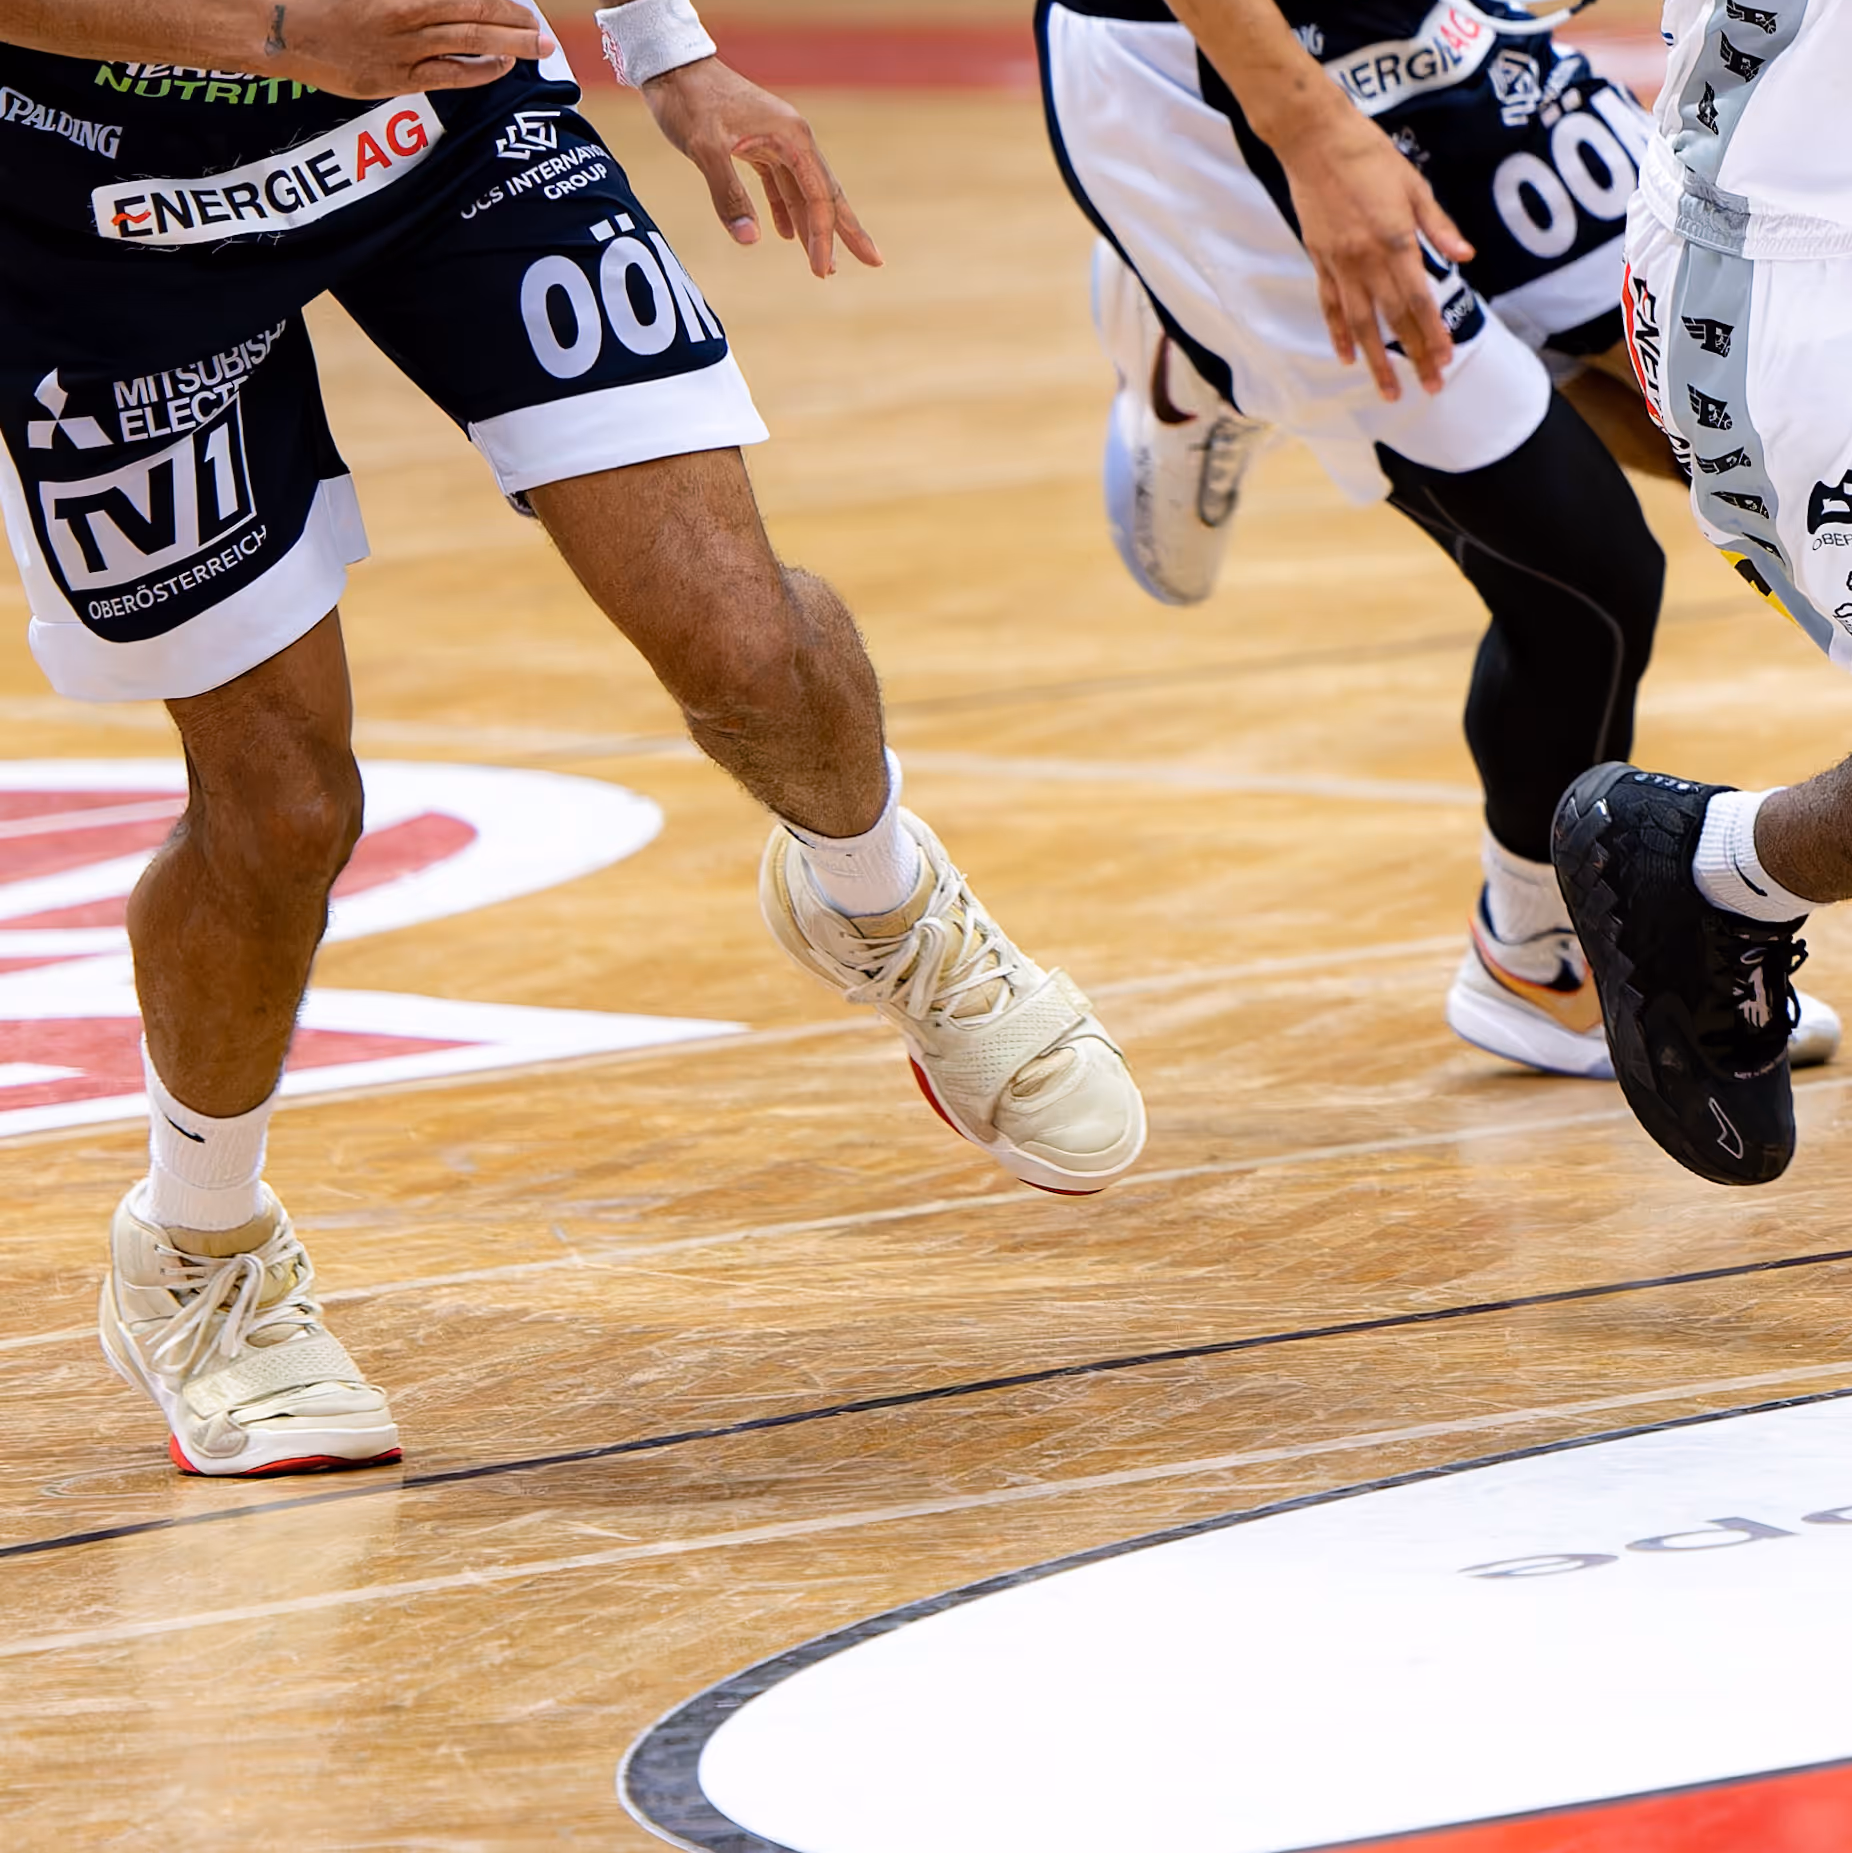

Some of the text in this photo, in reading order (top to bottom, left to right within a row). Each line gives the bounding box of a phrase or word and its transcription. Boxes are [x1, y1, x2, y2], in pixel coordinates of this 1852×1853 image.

[543, 162, 608, 200] GROUP
[53, 421, 240, 574] TV1
[88, 524, 267, 621] OBERÖSTERREICH
